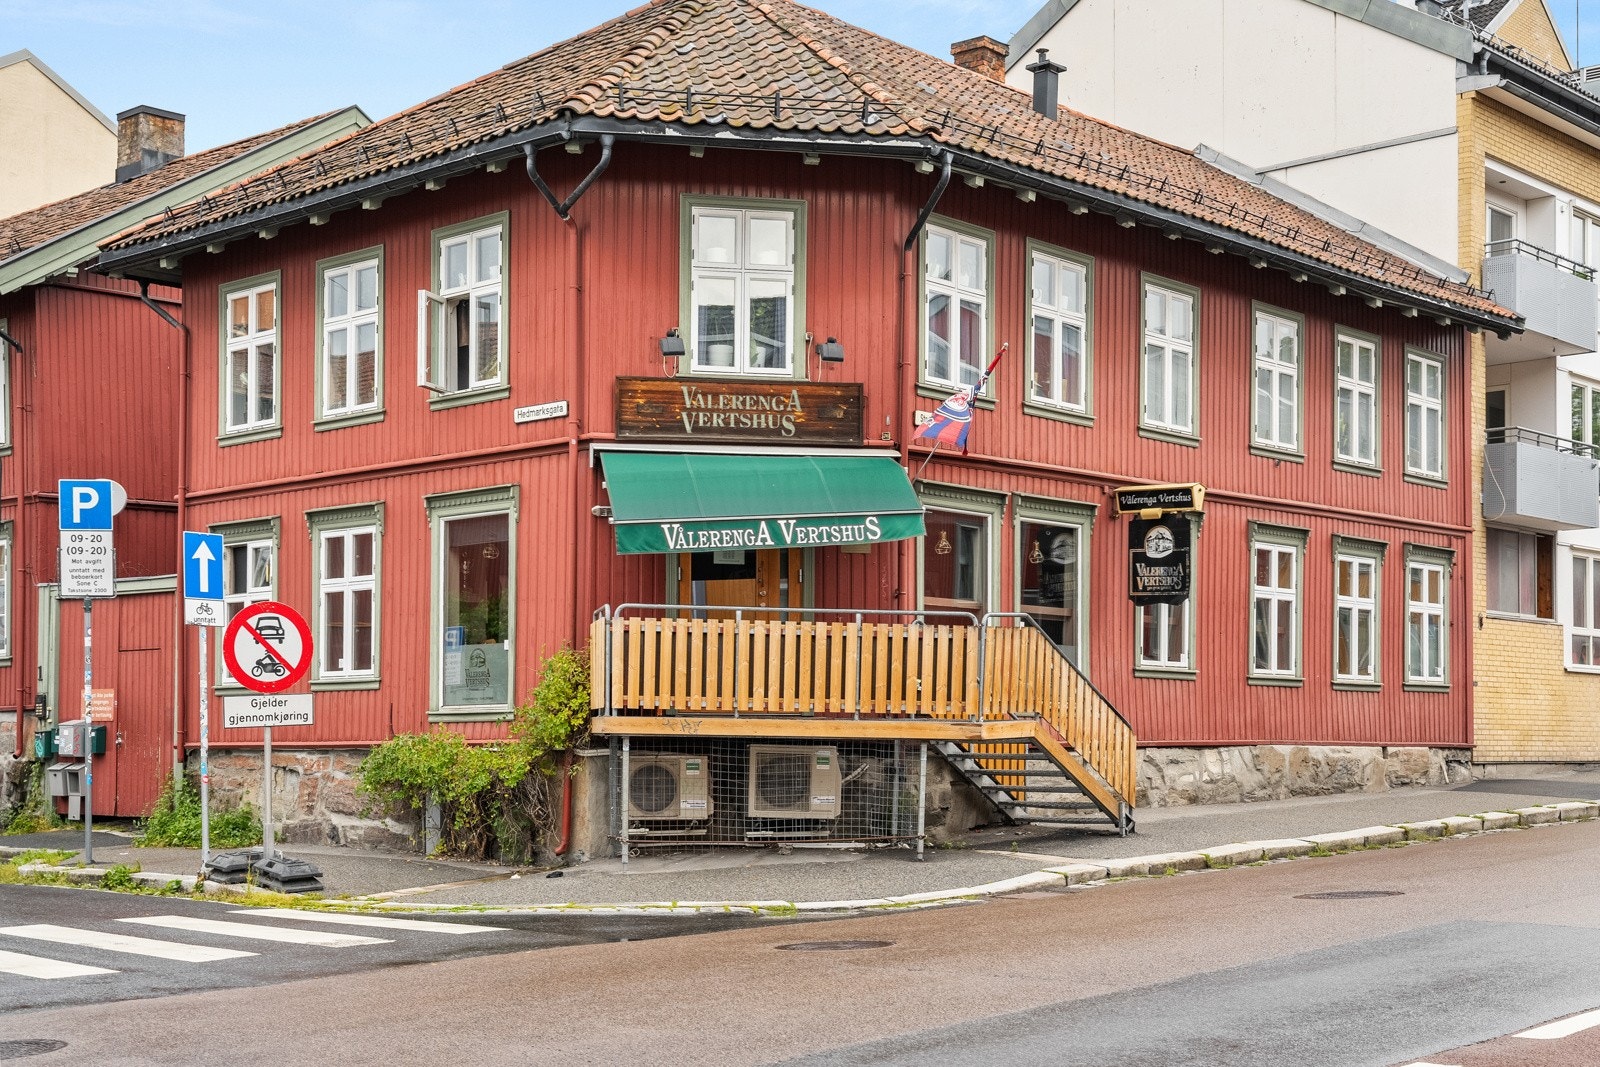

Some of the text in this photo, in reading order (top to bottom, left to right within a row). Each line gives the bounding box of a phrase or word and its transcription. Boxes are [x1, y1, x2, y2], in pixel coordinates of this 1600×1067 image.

[681, 385, 802, 412] VÅLERENGA
[517, 404, 564, 419] Hedmarksgata
[681, 412, 796, 437] VERTSHUS
[72, 486, 99, 524] P
[1121, 492, 1192, 506] Vålerenga Vertshus
[661, 516, 882, 549] VÅLERENGA VERTSHUS
[85, 558, 102, 566] avgift
[1136, 576, 1183, 590] VERTSHUS
[250, 699, 288, 710] Gjelder
[228, 711, 309, 726] gjennomkjøring
